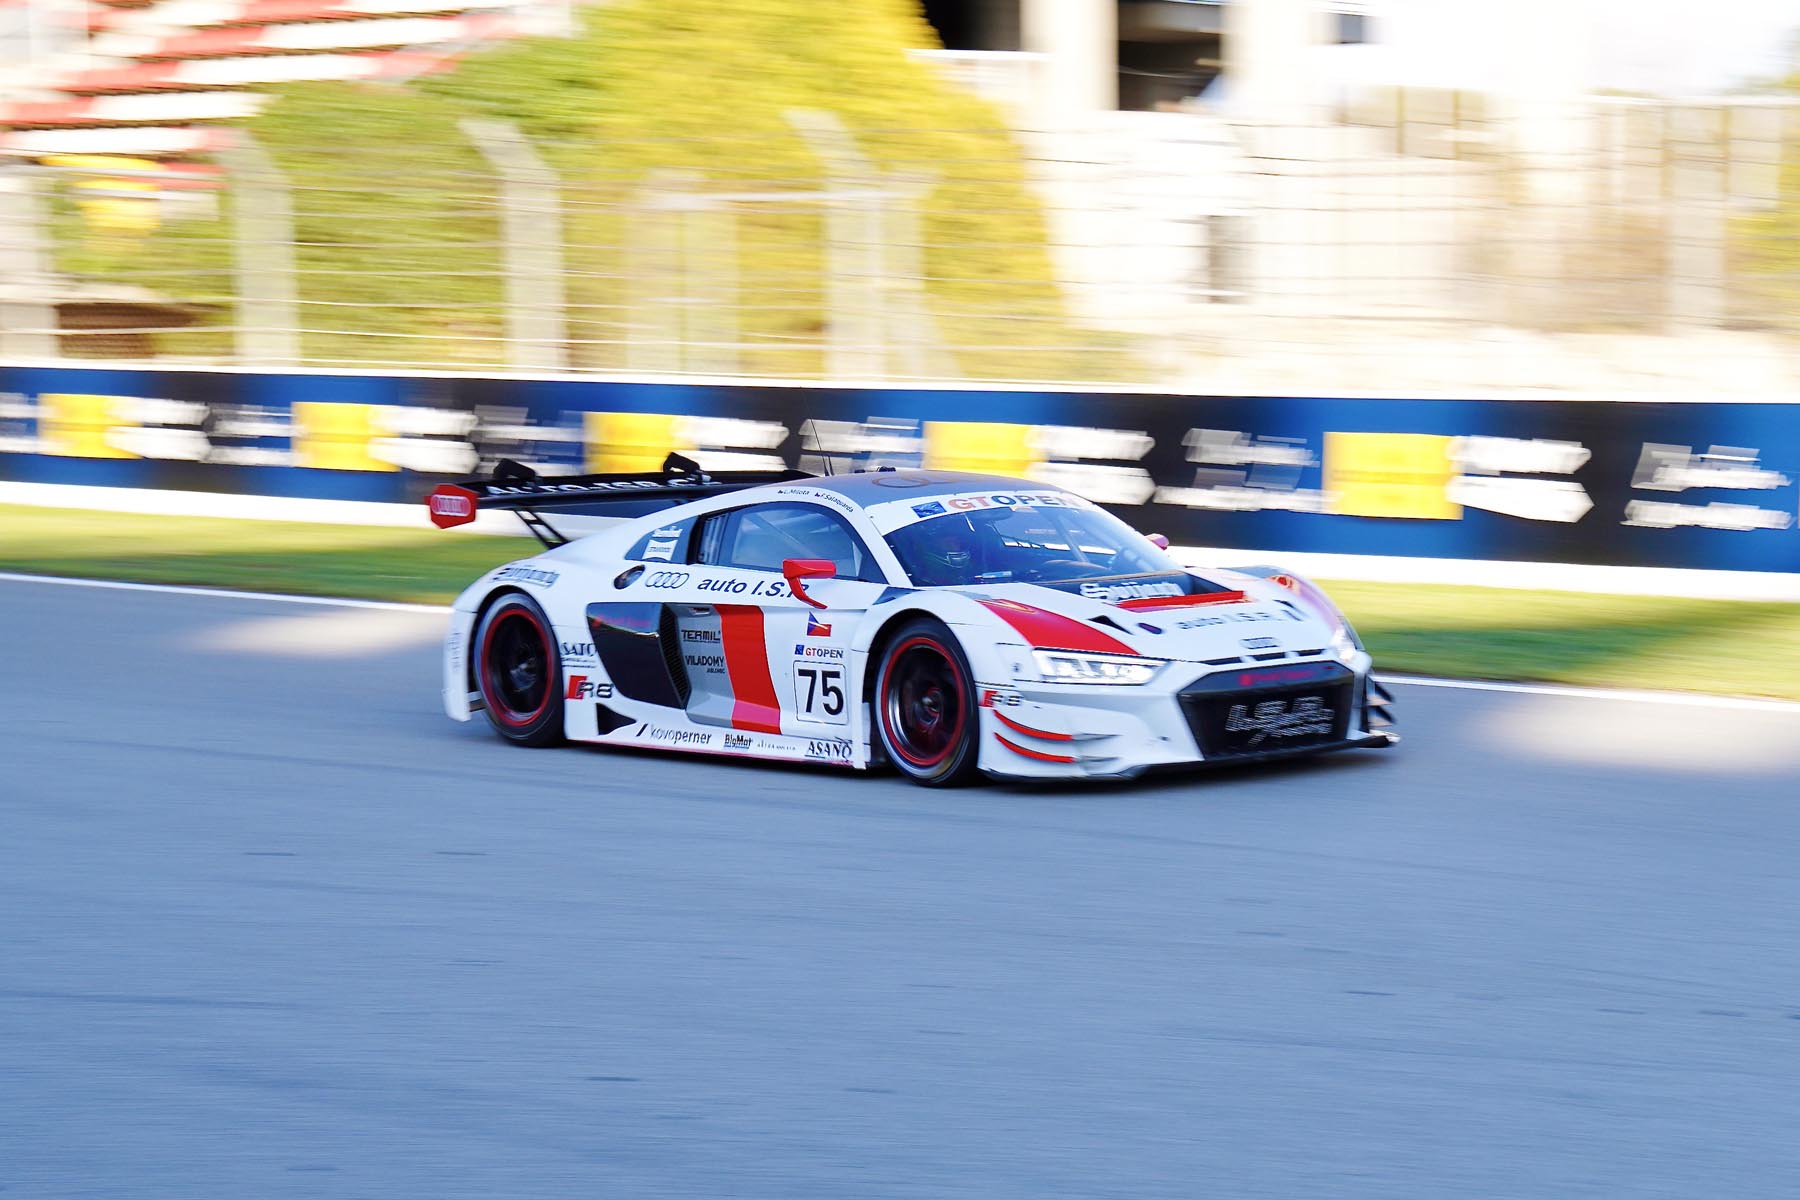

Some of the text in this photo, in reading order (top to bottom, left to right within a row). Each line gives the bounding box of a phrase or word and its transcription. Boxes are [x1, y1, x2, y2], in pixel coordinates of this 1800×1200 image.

[697, 578, 748, 594] auto
[577, 681, 614, 699] R8
[798, 668, 844, 716] 75
[650, 723, 712, 745] kovoperner
